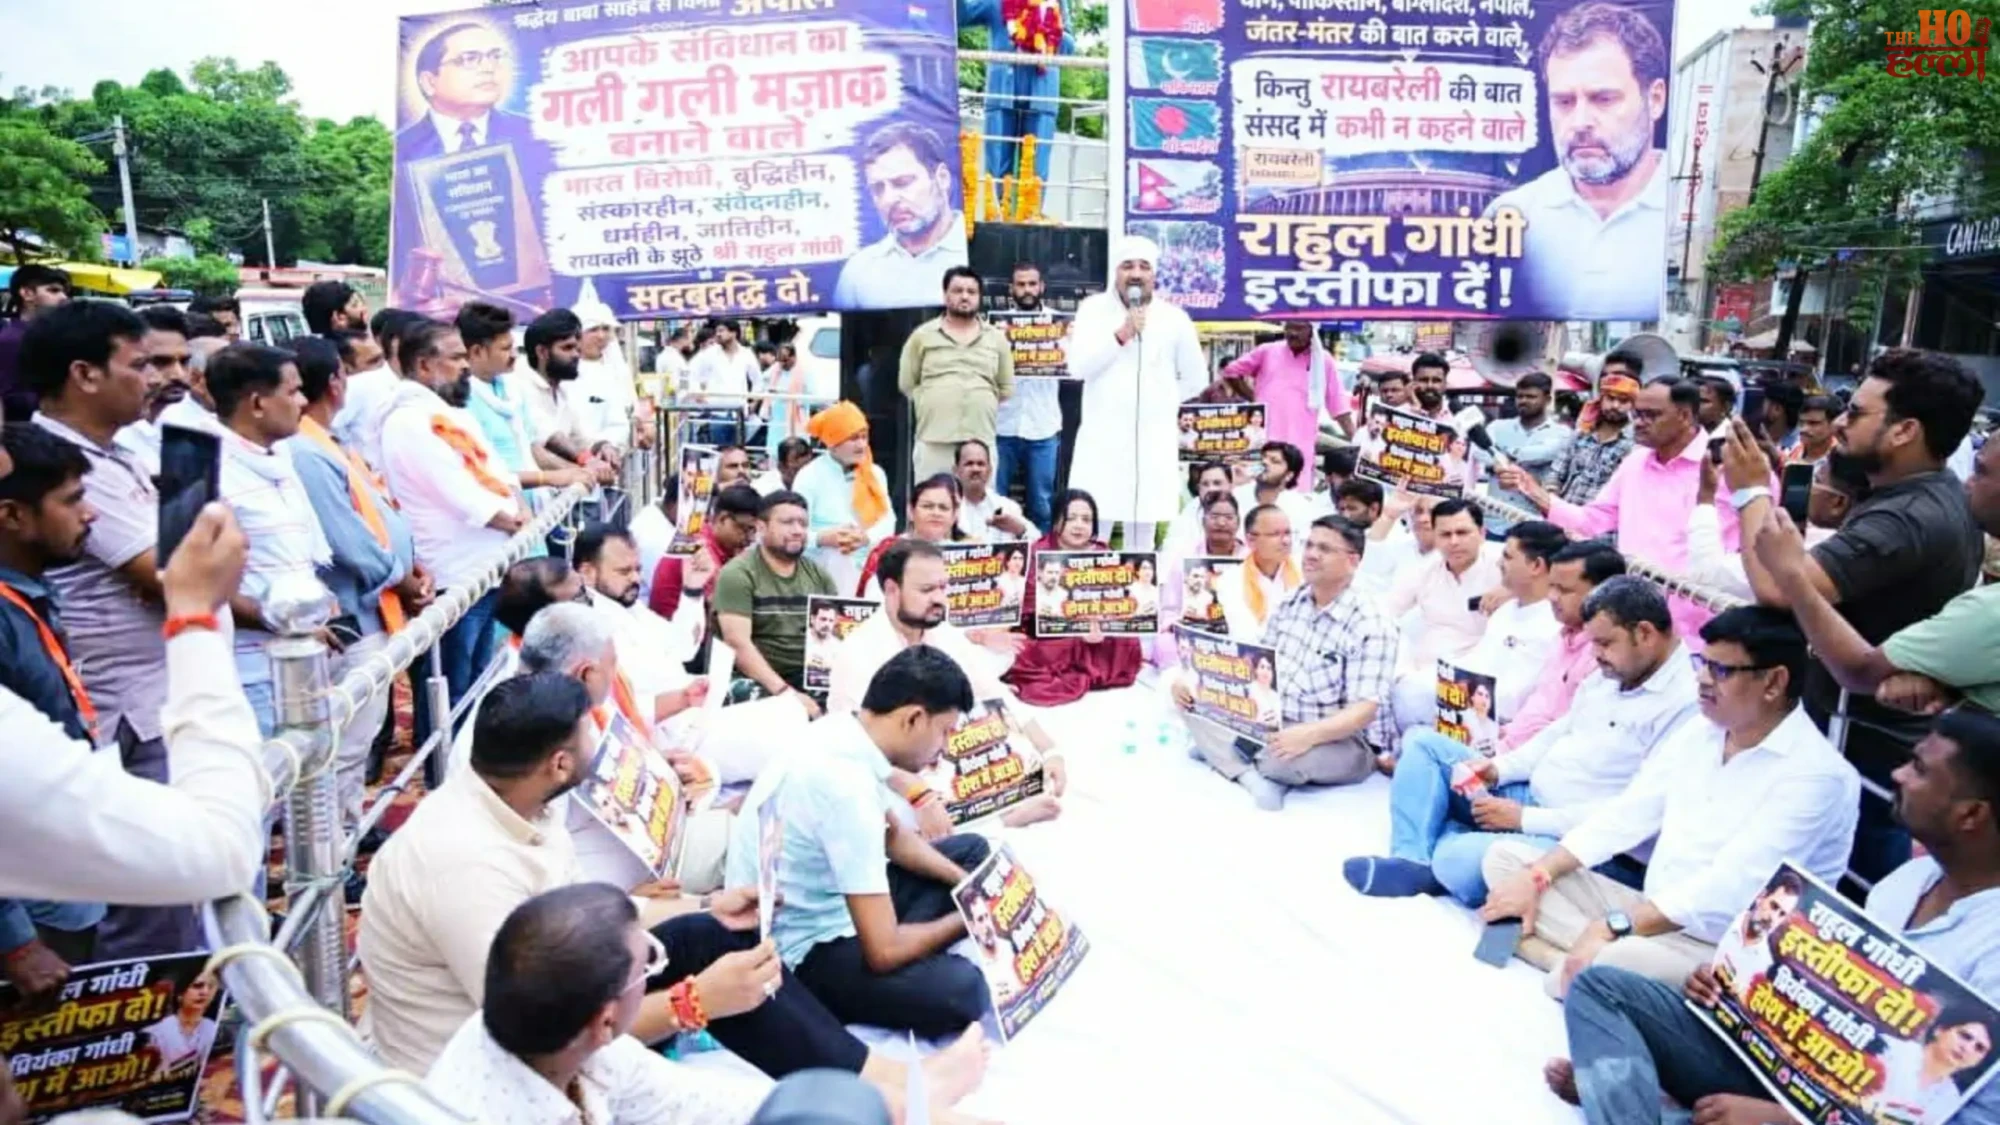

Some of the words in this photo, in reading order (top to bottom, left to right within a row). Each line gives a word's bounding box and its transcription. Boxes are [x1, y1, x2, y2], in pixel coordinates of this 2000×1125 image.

[562, 36, 660, 73] आपके
[669, 29, 798, 62] संविधान
[806, 26, 849, 54] का
[1245, 14, 1355, 44] जंतर-मंतर
[1359, 17, 1388, 44] की
[1390, 24, 1429, 45] बात
[1432, 19, 1481, 47] करने
[1483, 20, 1530, 50] वाले,
[541, 71, 626, 127] गली
[637, 63, 739, 119] गली
[750, 65, 887, 118] मज़ाक
[1255, 70, 1312, 108] किन्तु
[1320, 65, 1442, 102] रायबरेली
[1449, 74, 1482, 103] की
[1484, 81, 1523, 104] बात
[607, 121, 713, 157] बनाने
[723, 115, 807, 149] वाले
[1244, 108, 1301, 140] संसद
[1308, 108, 1328, 138] में
[1335, 107, 1385, 140] कभी
[1392, 116, 1411, 140] न
[1417, 110, 1476, 143] कहने
[1481, 111, 1528, 142] वाले
[563, 170, 625, 196] भारत
[633, 163, 722, 191] विरोधी,
[731, 159, 836, 191] बुद्धिहीन,
[577, 194, 704, 222] संस्कारहीन,
[712, 188, 830, 212] संवेदनहीन,
[602, 221, 689, 245] धर्महीन,
[696, 214, 801, 240] जातिहीन,
[1235, 215, 1391, 271] राहुल
[1402, 205, 1529, 258] गांधी
[647, 245, 665, 264] के
[671, 243, 704, 269] झूठे
[713, 239, 739, 260] श्री
[744, 242, 796, 266] राहुल
[801, 235, 845, 255] गांधी
[775, 269, 820, 305] दो.
[1242, 261, 1442, 313] इस्तीफा
[1065, 567, 1113, 588] इस्तीफा
[1809, 900, 1867, 947] राहुल
[1862, 935, 1927, 986] गांधी
[89, 963, 150, 994] गांधी
[1778, 924, 1883, 1004] इस्तीफा
[1875, 986, 1927, 1036] दो!
[0, 1000, 121, 1052] इस्तीफा
[123, 988, 167, 1023] दो!
[1772, 964, 1827, 1017] प्रियंका
[1822, 1006, 1877, 1051] गांधी
[10, 1046, 82, 1076] प्रियंका
[84, 1030, 136, 1060] गांधी
[1748, 979, 1787, 1026] होश
[1783, 1007, 1811, 1041] में
[1798, 1027, 1876, 1093] आओ!
[44, 1064, 73, 1095] में
[72, 1053, 151, 1093] आओ!
